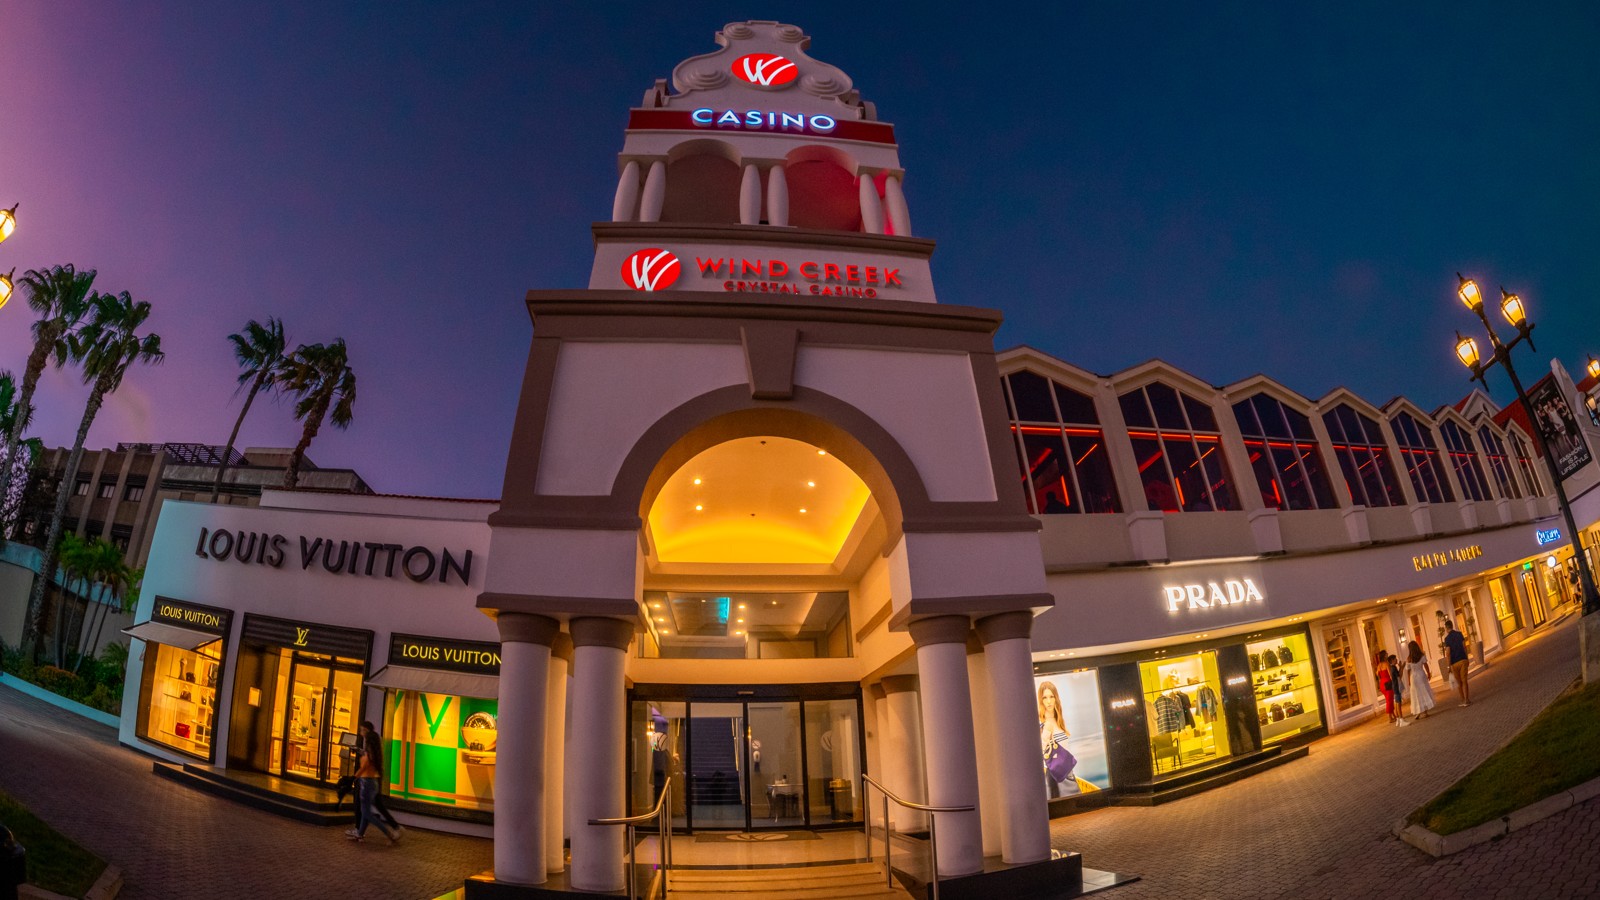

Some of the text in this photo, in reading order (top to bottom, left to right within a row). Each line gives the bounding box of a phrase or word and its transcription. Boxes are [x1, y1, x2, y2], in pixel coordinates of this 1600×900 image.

[691, 108, 836, 130] CASINO
[696, 257, 902, 287] WIND CREEK
[723, 280, 877, 298] CRYSTAL CASINO
[195, 526, 472, 586] LOUIS VUITTON
[1164, 578, 1264, 613] PRADA
[160, 604, 220, 627] LOUIS VUITTON
[402, 644, 502, 666] LOUIS VUITTON
